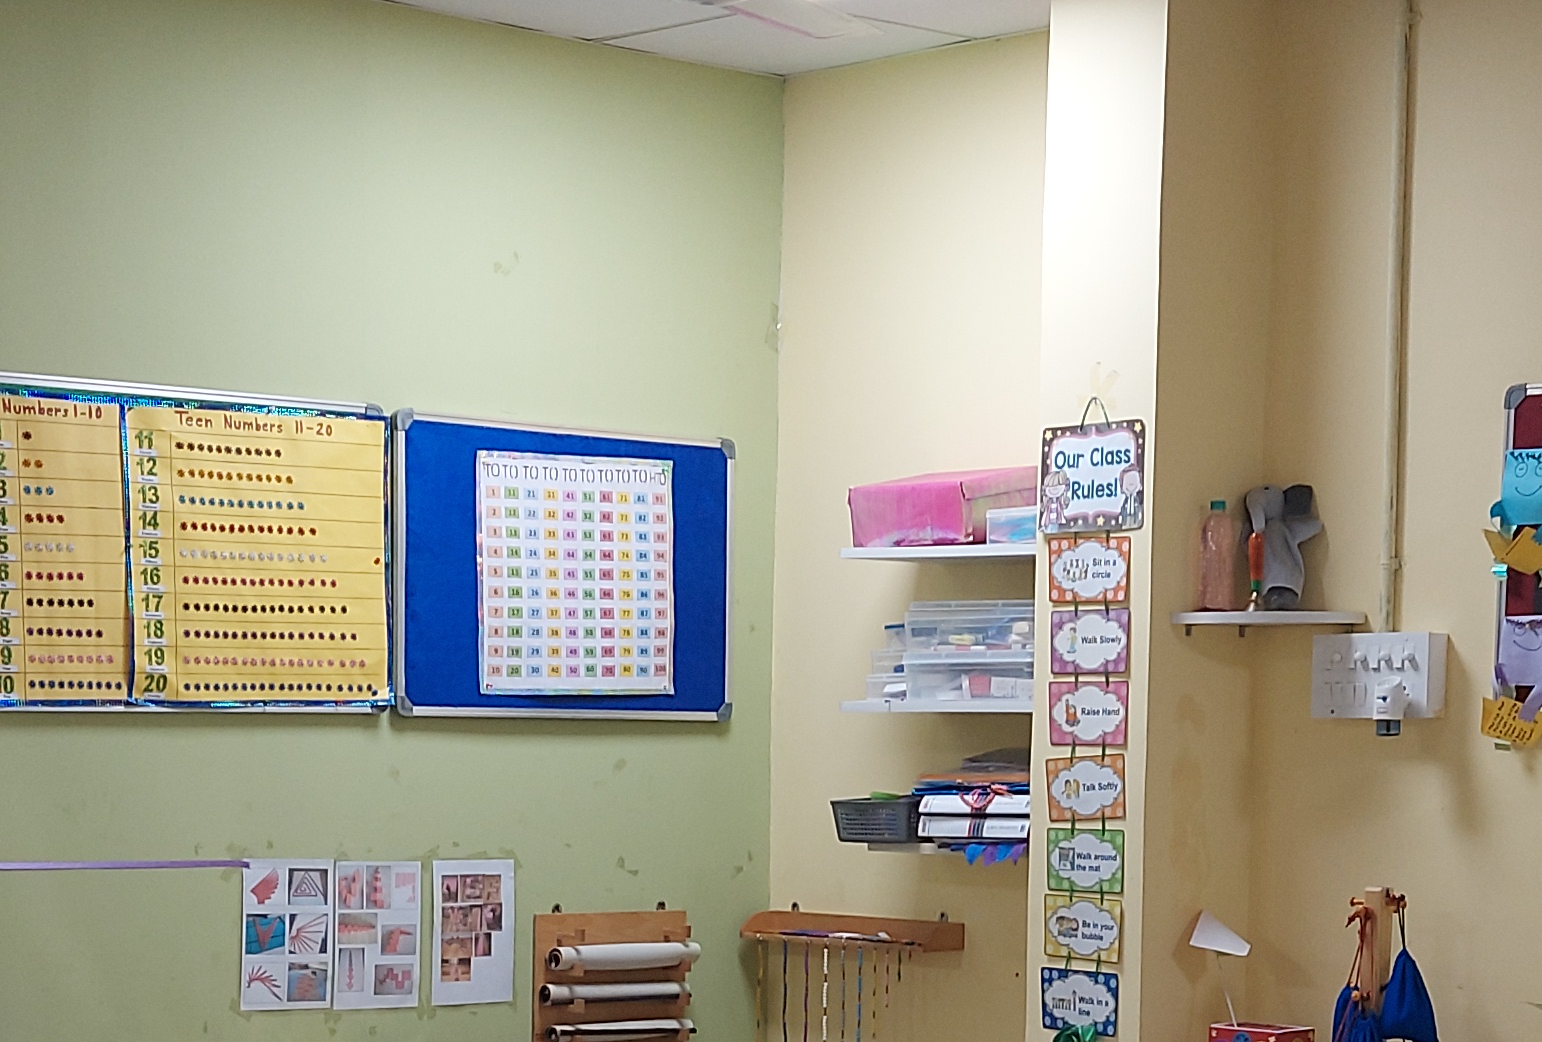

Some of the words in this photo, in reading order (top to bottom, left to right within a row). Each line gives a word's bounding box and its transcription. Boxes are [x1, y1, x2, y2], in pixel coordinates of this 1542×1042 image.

[2, 397, 69, 418] Numbers
[74, 404, 103, 419] 1-10
[174, 410, 213, 428] Teen
[223, 414, 283, 434] Numbers
[295, 420, 333, 437] 11-20
[136, 457, 158, 476] 12
[1054, 449, 1085, 471] Our
[1090, 448, 1131, 467] Class
[138, 485, 160, 504] 13
[1072, 479, 1118, 501] Rules!
[139, 511, 159, 530] 14
[139, 540, 159, 559] 15
[1092, 558, 1102, 566] Sit
[1104, 558, 1111, 566] in
[140, 567, 161, 586] 16
[1091, 570, 1111, 579] circle
[141, 594, 164, 613] 17
[0, 617, 10, 637] 8
[143, 619, 165, 639] 18
[1081, 635, 1098, 645] Walk
[1099, 635, 1122, 645] Slowly
[0, 645, 12, 666] 9
[144, 647, 165, 666] 19
[143, 674, 167, 693] 20
[1081, 707, 1100, 716] Raise
[1102, 707, 1120, 716] Hand
[1082, 783, 1096, 792] Talk
[1098, 782, 1118, 792] Softly
[1076, 852, 1092, 860] Walk
[1082, 920, 1091, 928] Be
[1100, 924, 1114, 932] your
[1081, 932, 1104, 941] bubble
[1078, 996, 1094, 1005] Walk
